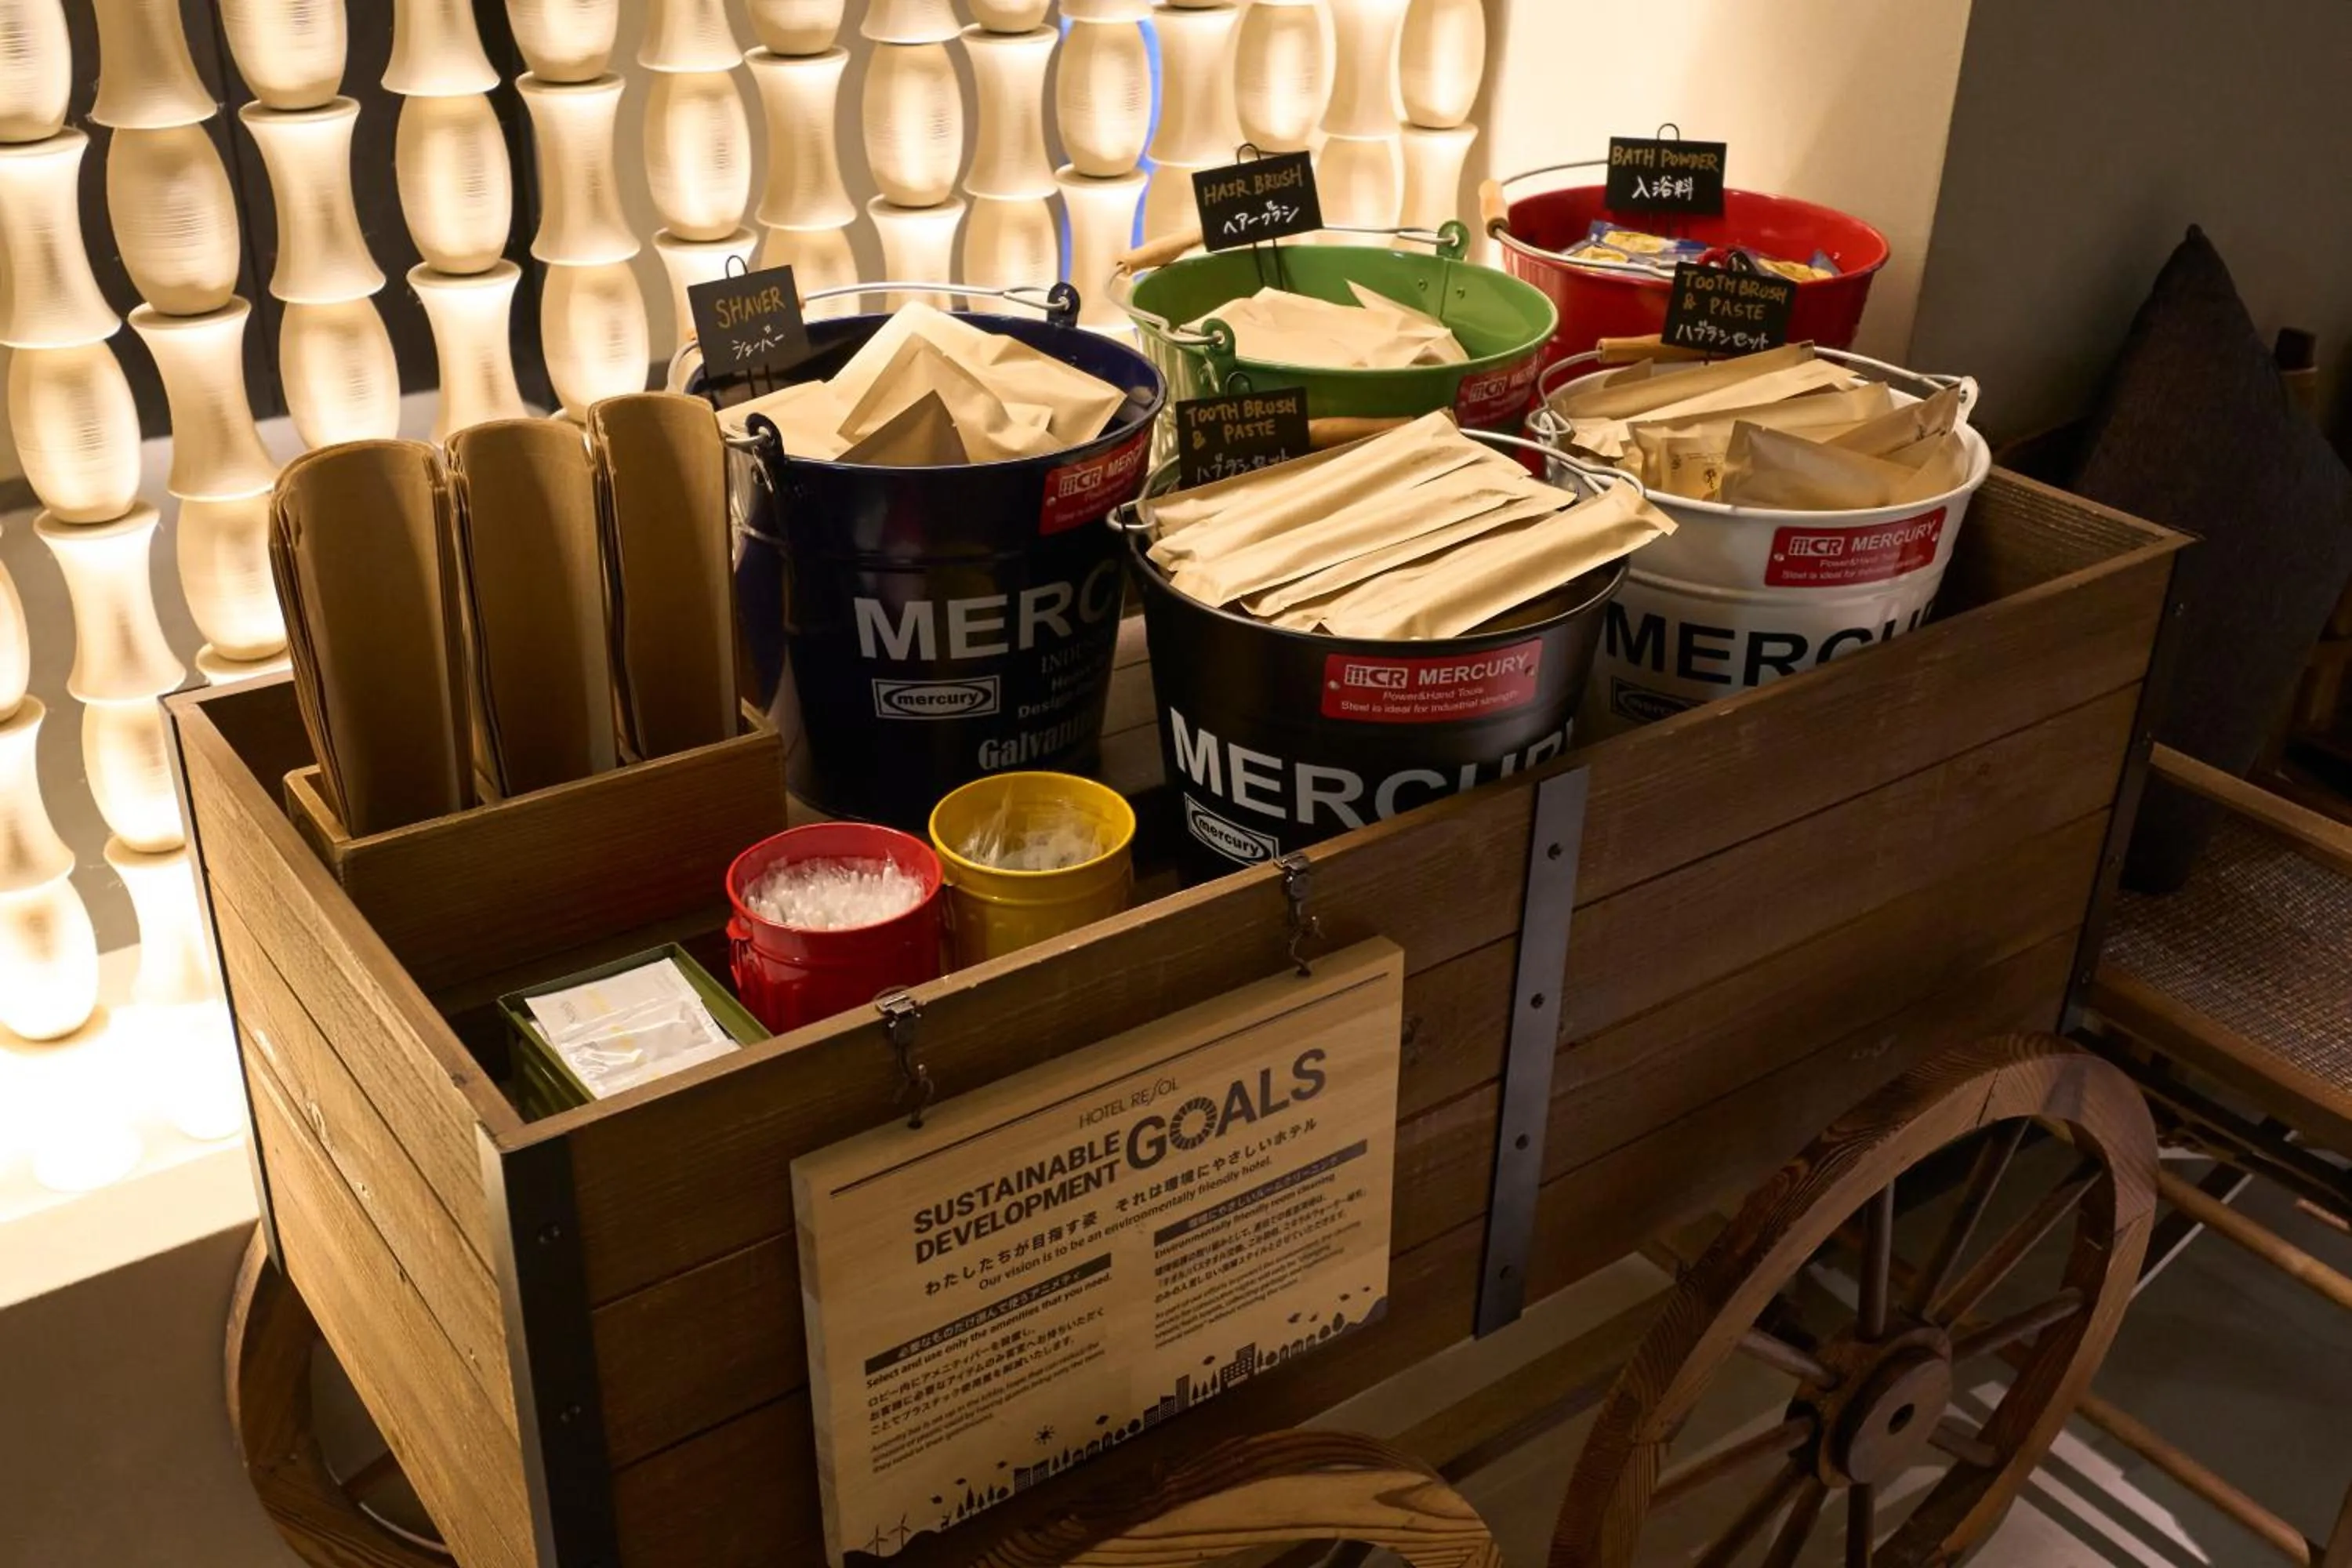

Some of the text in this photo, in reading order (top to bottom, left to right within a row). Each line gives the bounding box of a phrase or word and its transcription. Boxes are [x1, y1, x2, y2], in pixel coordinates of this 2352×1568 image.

[1611, 145, 1719, 173] BATH POWDER
[1203, 163, 1303, 206] HAIR BRUSH
[1632, 175, 1693, 201] 入浴料
[1682, 270, 1788, 304] TOOTH BRUSH
[714, 286, 786, 328] SHAVER
[1709, 296, 1766, 321] PASTE
[1675, 319, 1769, 350] ハブラシセット
[1185, 397, 1298, 428] TOOTH BRUSH
[1223, 418, 1276, 445] PASTE
[1851, 519, 1936, 552] MERCURY
[1417, 652, 1529, 686] MERCURY
[897, 689, 979, 708] mercury
[1196, 818, 1260, 855] mercury
[1079, 1098, 1125, 1128] HOTEL
[1127, 1047, 1327, 1171] GOALS
[913, 1133, 1120, 1232] SUSTAINABLE
[916, 1162, 1120, 1260] DEVELOPMENT
[924, 1213, 1098, 1294] わたしたちが目指す姿
[1116, 1120, 1316, 1210] それは環境にやさしいホテル
[978, 1272, 1001, 1290] Our
[1004, 1256, 1040, 1279] vision
[1055, 1243, 1067, 1258] to
[1070, 1236, 1084, 1250] be
[1087, 1230, 1102, 1243] an
[1105, 1190, 1195, 1234] environmentally
[1199, 1170, 1239, 1195] friendly
[1242, 1156, 1270, 1175] hotel.
[866, 1270, 1112, 1388] Select and use only the amenities that you need.
